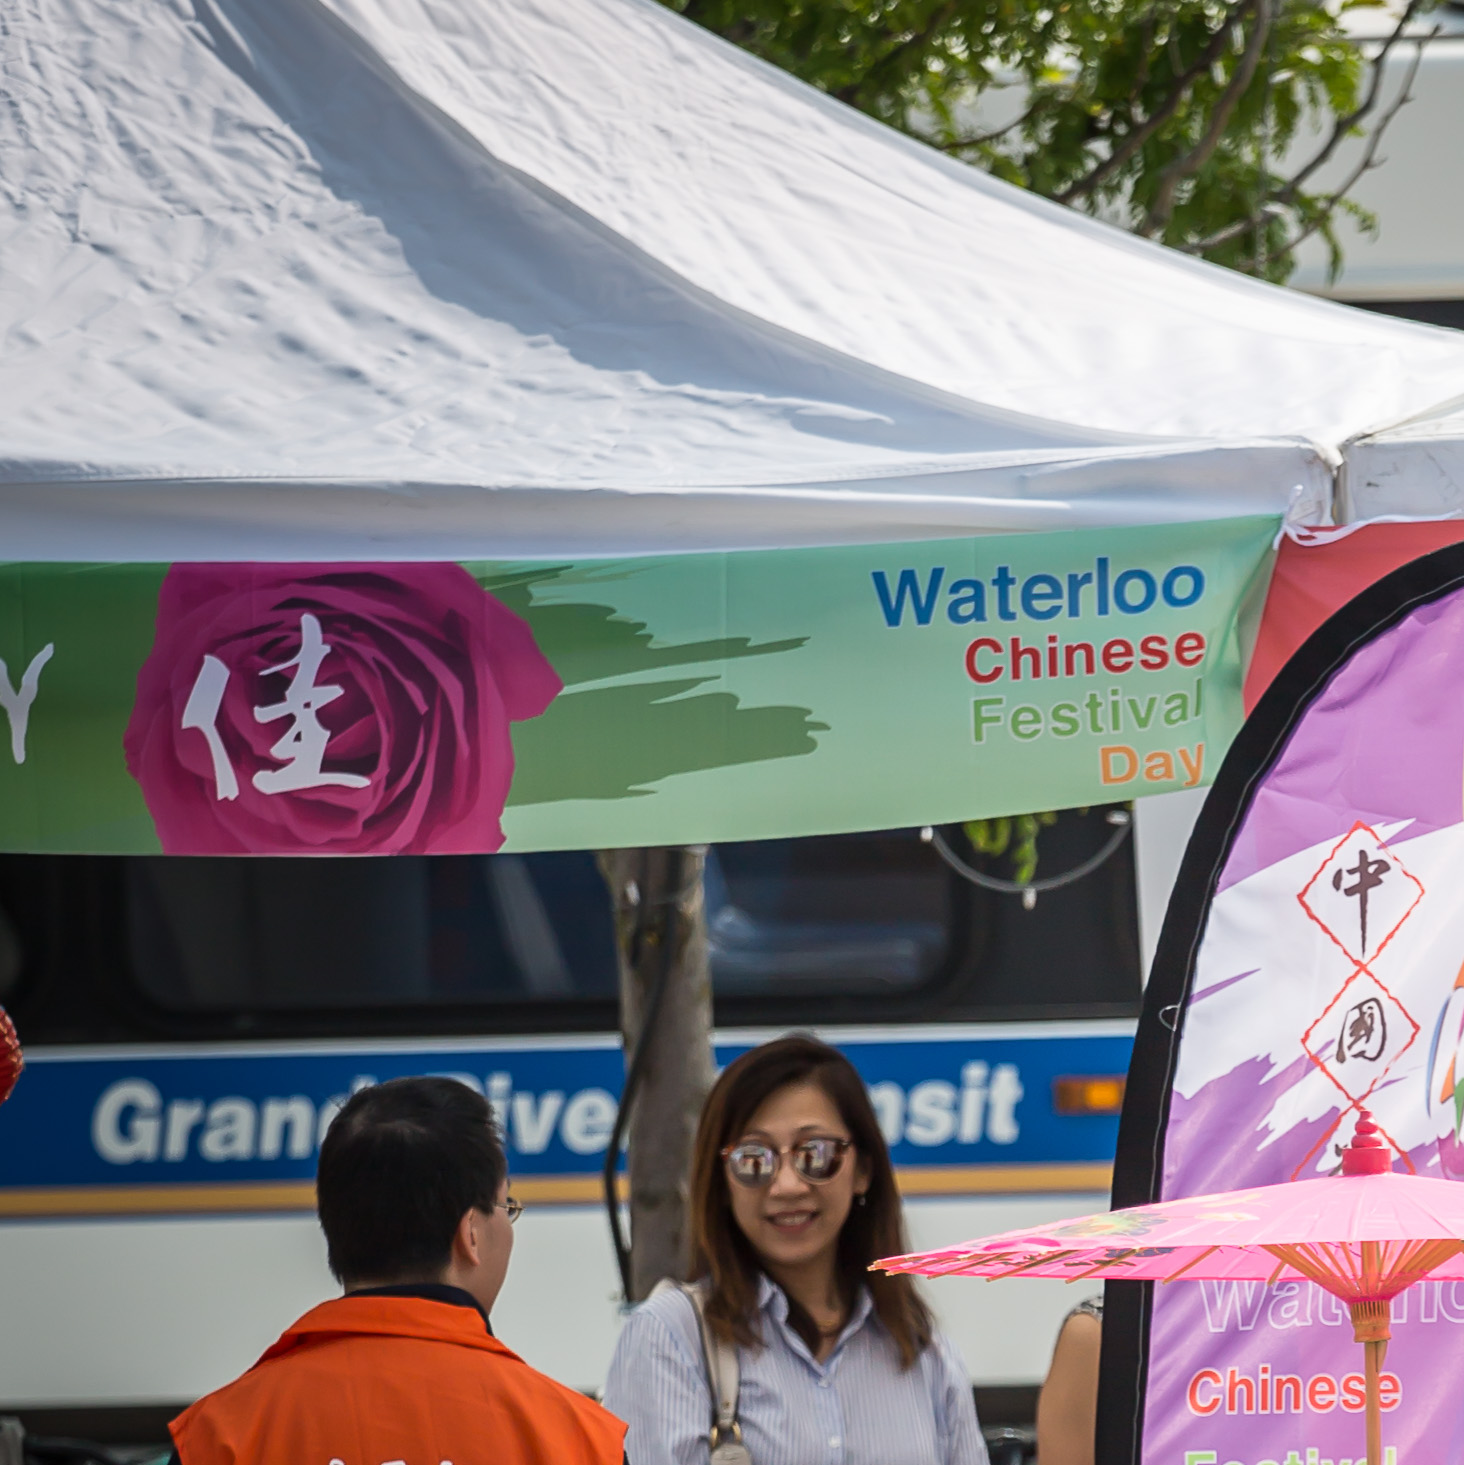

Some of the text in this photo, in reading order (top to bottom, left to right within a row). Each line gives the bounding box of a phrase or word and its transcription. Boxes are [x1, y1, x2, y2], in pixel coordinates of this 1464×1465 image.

[870, 556, 1206, 628] Waterloo
[965, 631, 1207, 684] Chinese
[181, 613, 371, 801] 佳
[973, 678, 1203, 743] Festival
[1100, 743, 1205, 787] Day
[868, 1058, 1024, 1148] nsit
[1187, 1362, 1403, 1418] Chinese
